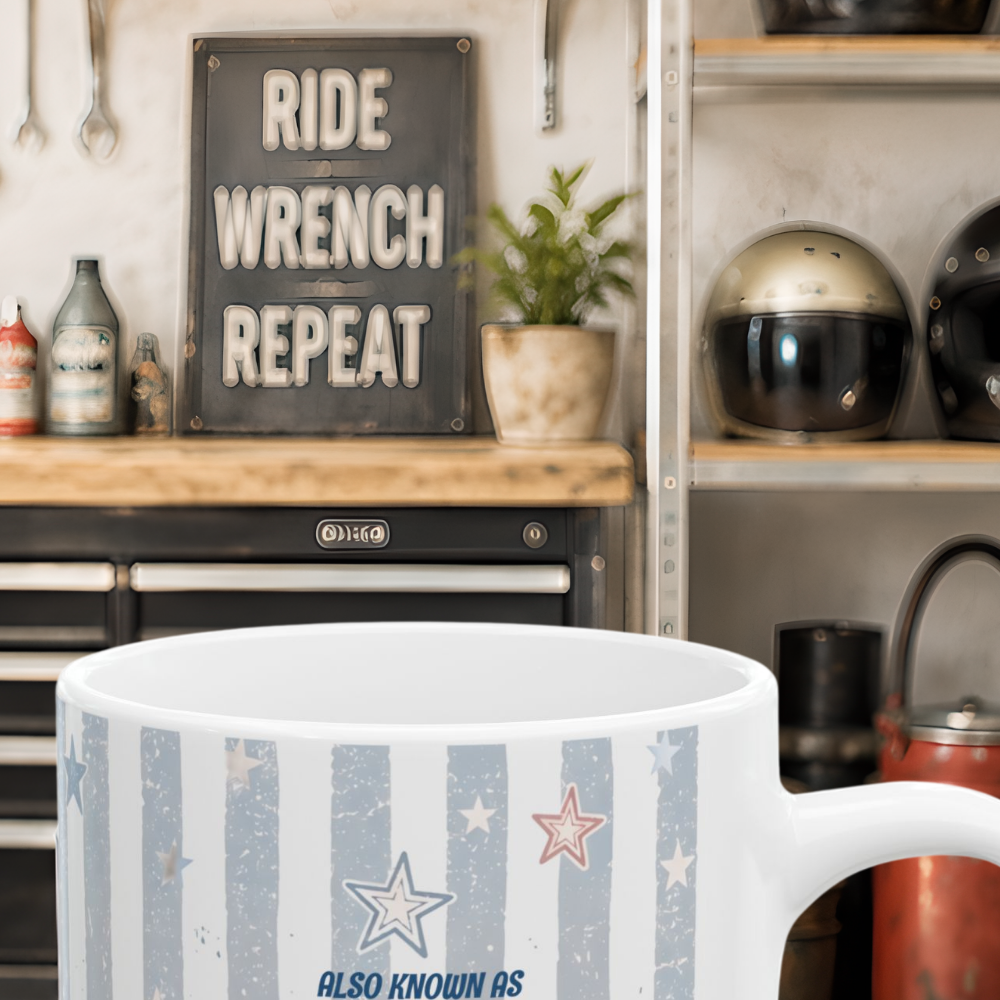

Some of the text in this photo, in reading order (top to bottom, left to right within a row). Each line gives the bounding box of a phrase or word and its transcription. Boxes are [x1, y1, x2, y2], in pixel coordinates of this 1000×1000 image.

[262, 67, 393, 151] RIDE
[213, 183, 445, 270] WRENCH
[222, 303, 432, 389] REPEAT
[316, 969, 525, 1000] ALSO KNOWN AS
